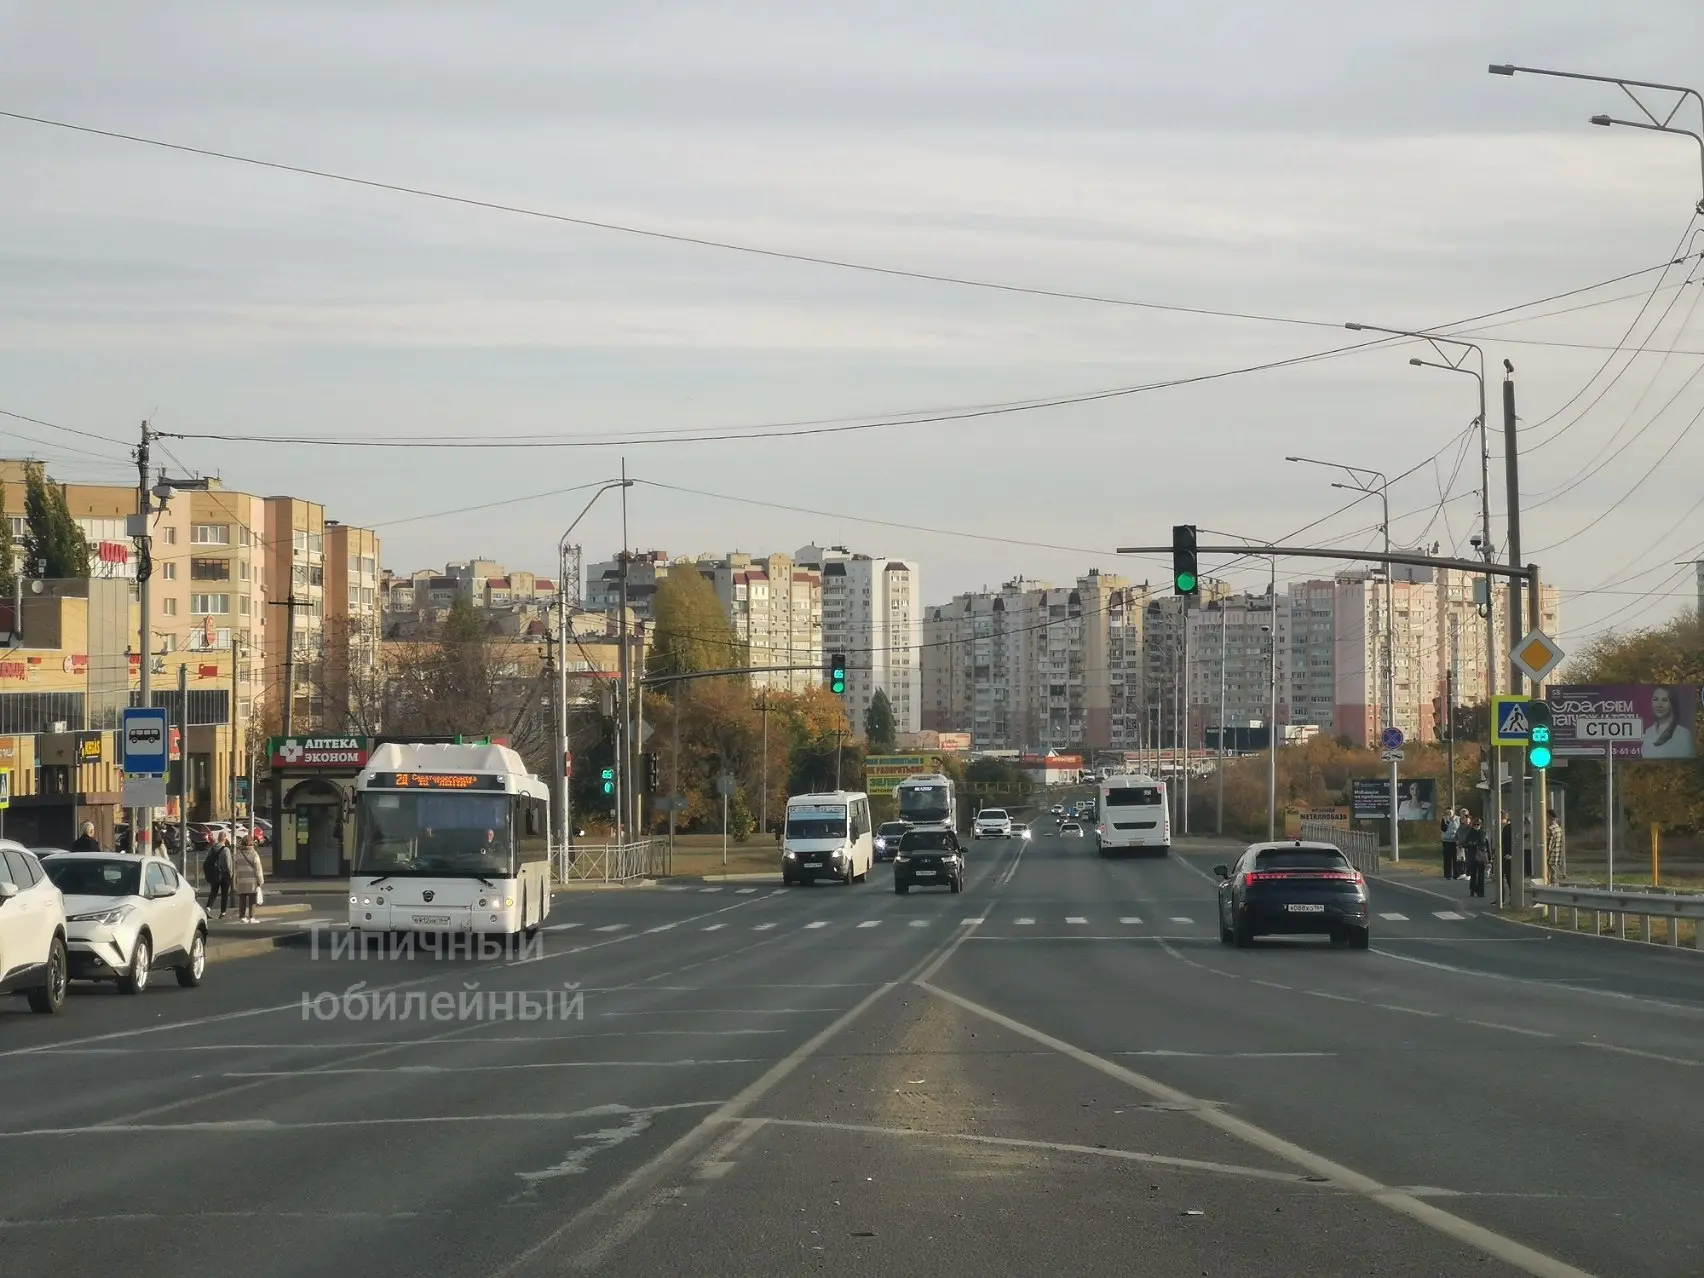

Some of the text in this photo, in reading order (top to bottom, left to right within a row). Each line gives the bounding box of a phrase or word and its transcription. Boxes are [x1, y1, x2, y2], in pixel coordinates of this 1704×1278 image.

[1586, 722, 1633, 736] СТОП
[304, 739, 358, 749] АПТЕКА
[304, 752, 359, 763] ЭКОНОМ
